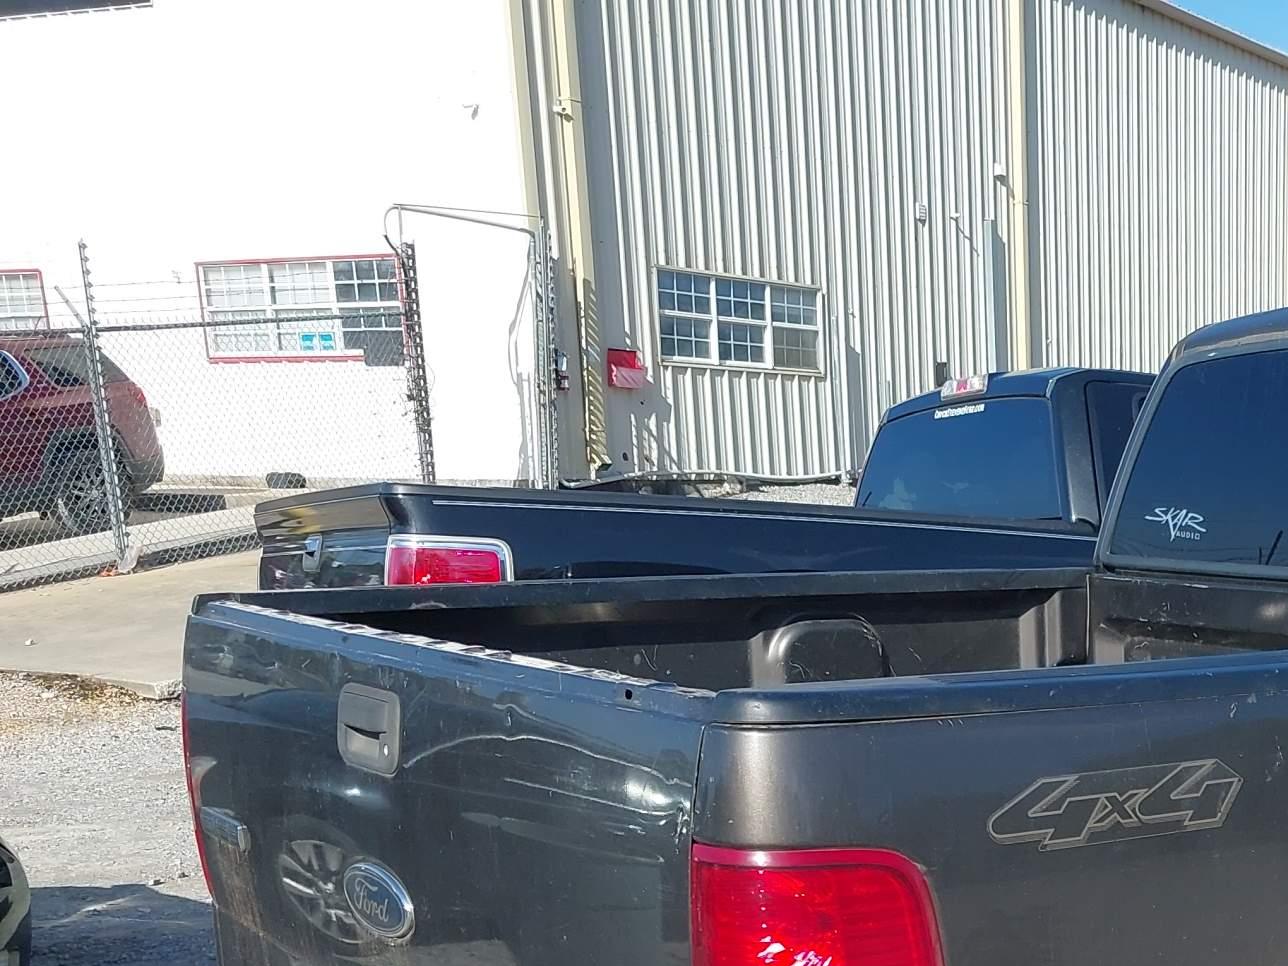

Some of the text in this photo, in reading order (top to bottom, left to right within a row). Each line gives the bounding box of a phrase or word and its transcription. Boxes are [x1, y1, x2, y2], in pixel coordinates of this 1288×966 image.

[1144, 507, 1207, 542] SKAR
[1175, 530, 1201, 540] AUDIO
[354, 877, 390, 923] Ford
